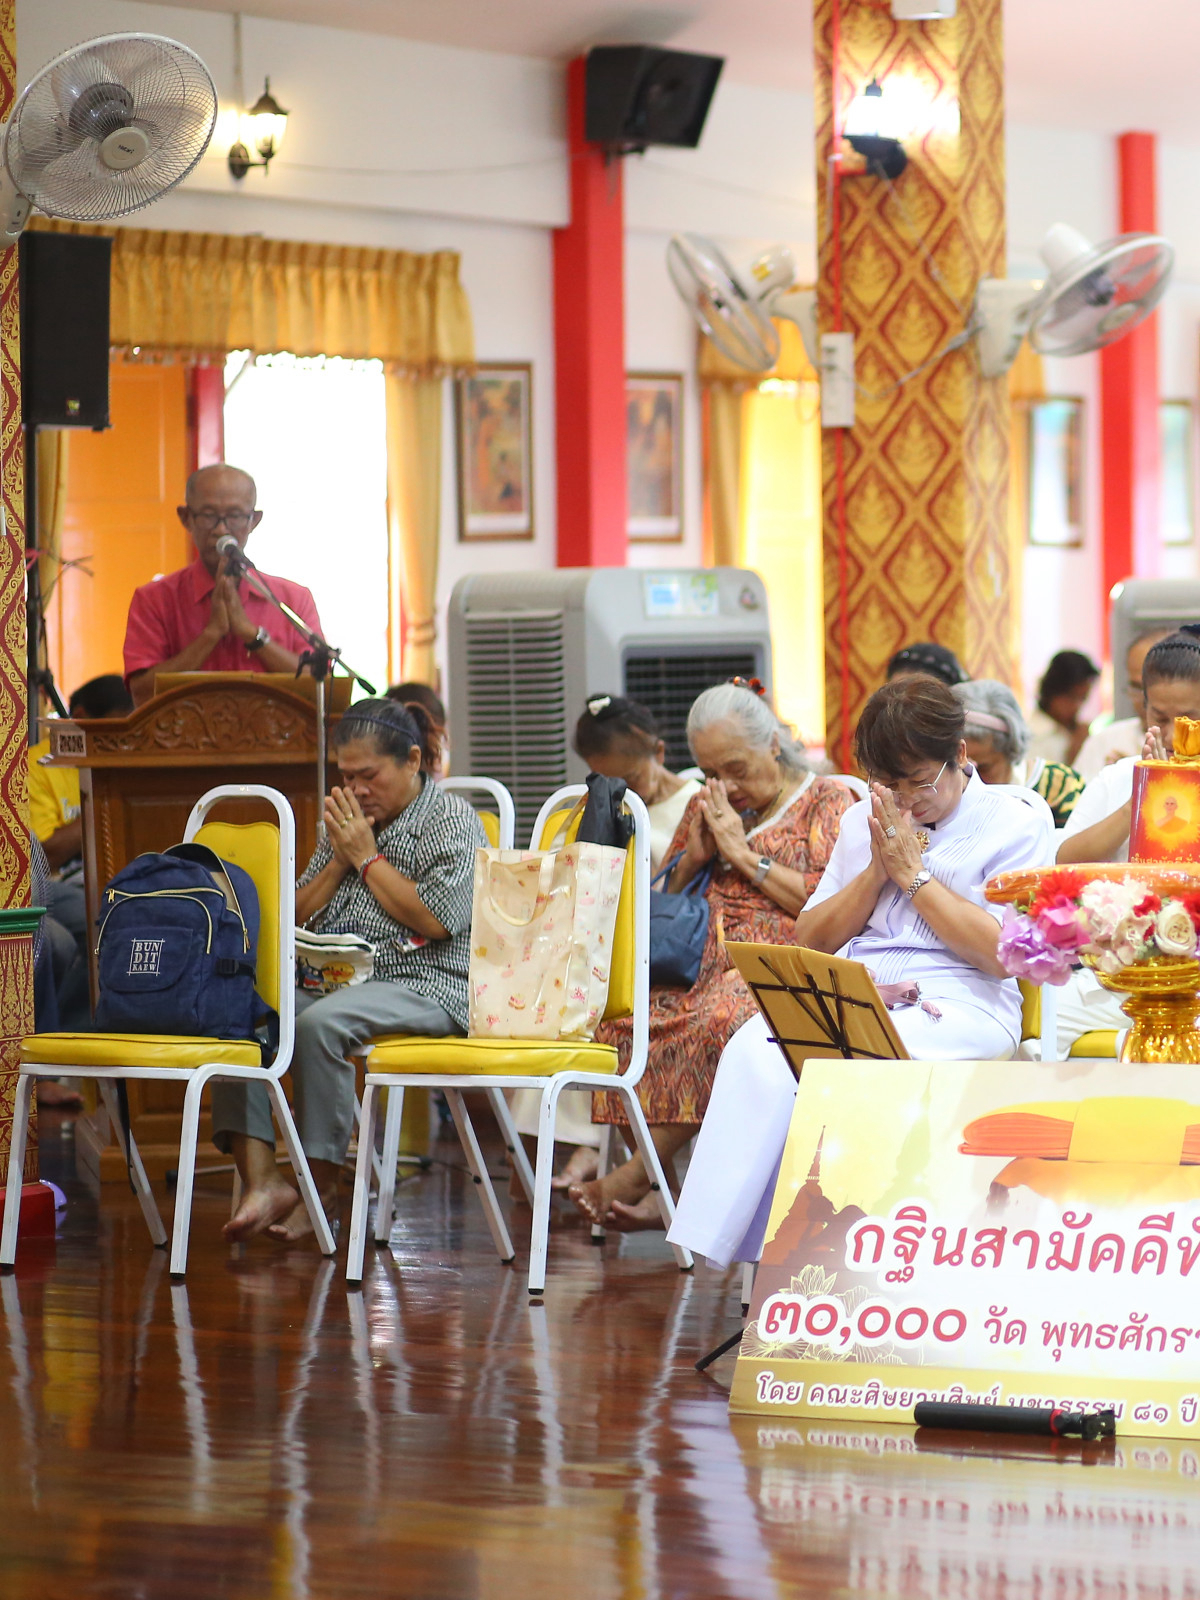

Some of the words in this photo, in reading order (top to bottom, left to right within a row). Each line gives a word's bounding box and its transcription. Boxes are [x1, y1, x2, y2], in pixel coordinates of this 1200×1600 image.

[133, 952, 159, 963] DIT
[134, 942, 160, 951] BUN
[764, 1301, 968, 1346] ๓๐,๐๐๐
[983, 1305, 1027, 1346] วัด
[758, 1375, 802, 1401] โดย
[809, 1382, 1000, 1407] คณะศิษยานศิษย์
[1133, 1400, 1169, 1423] ๘๑
[1180, 1398, 1198, 1423] ปี
